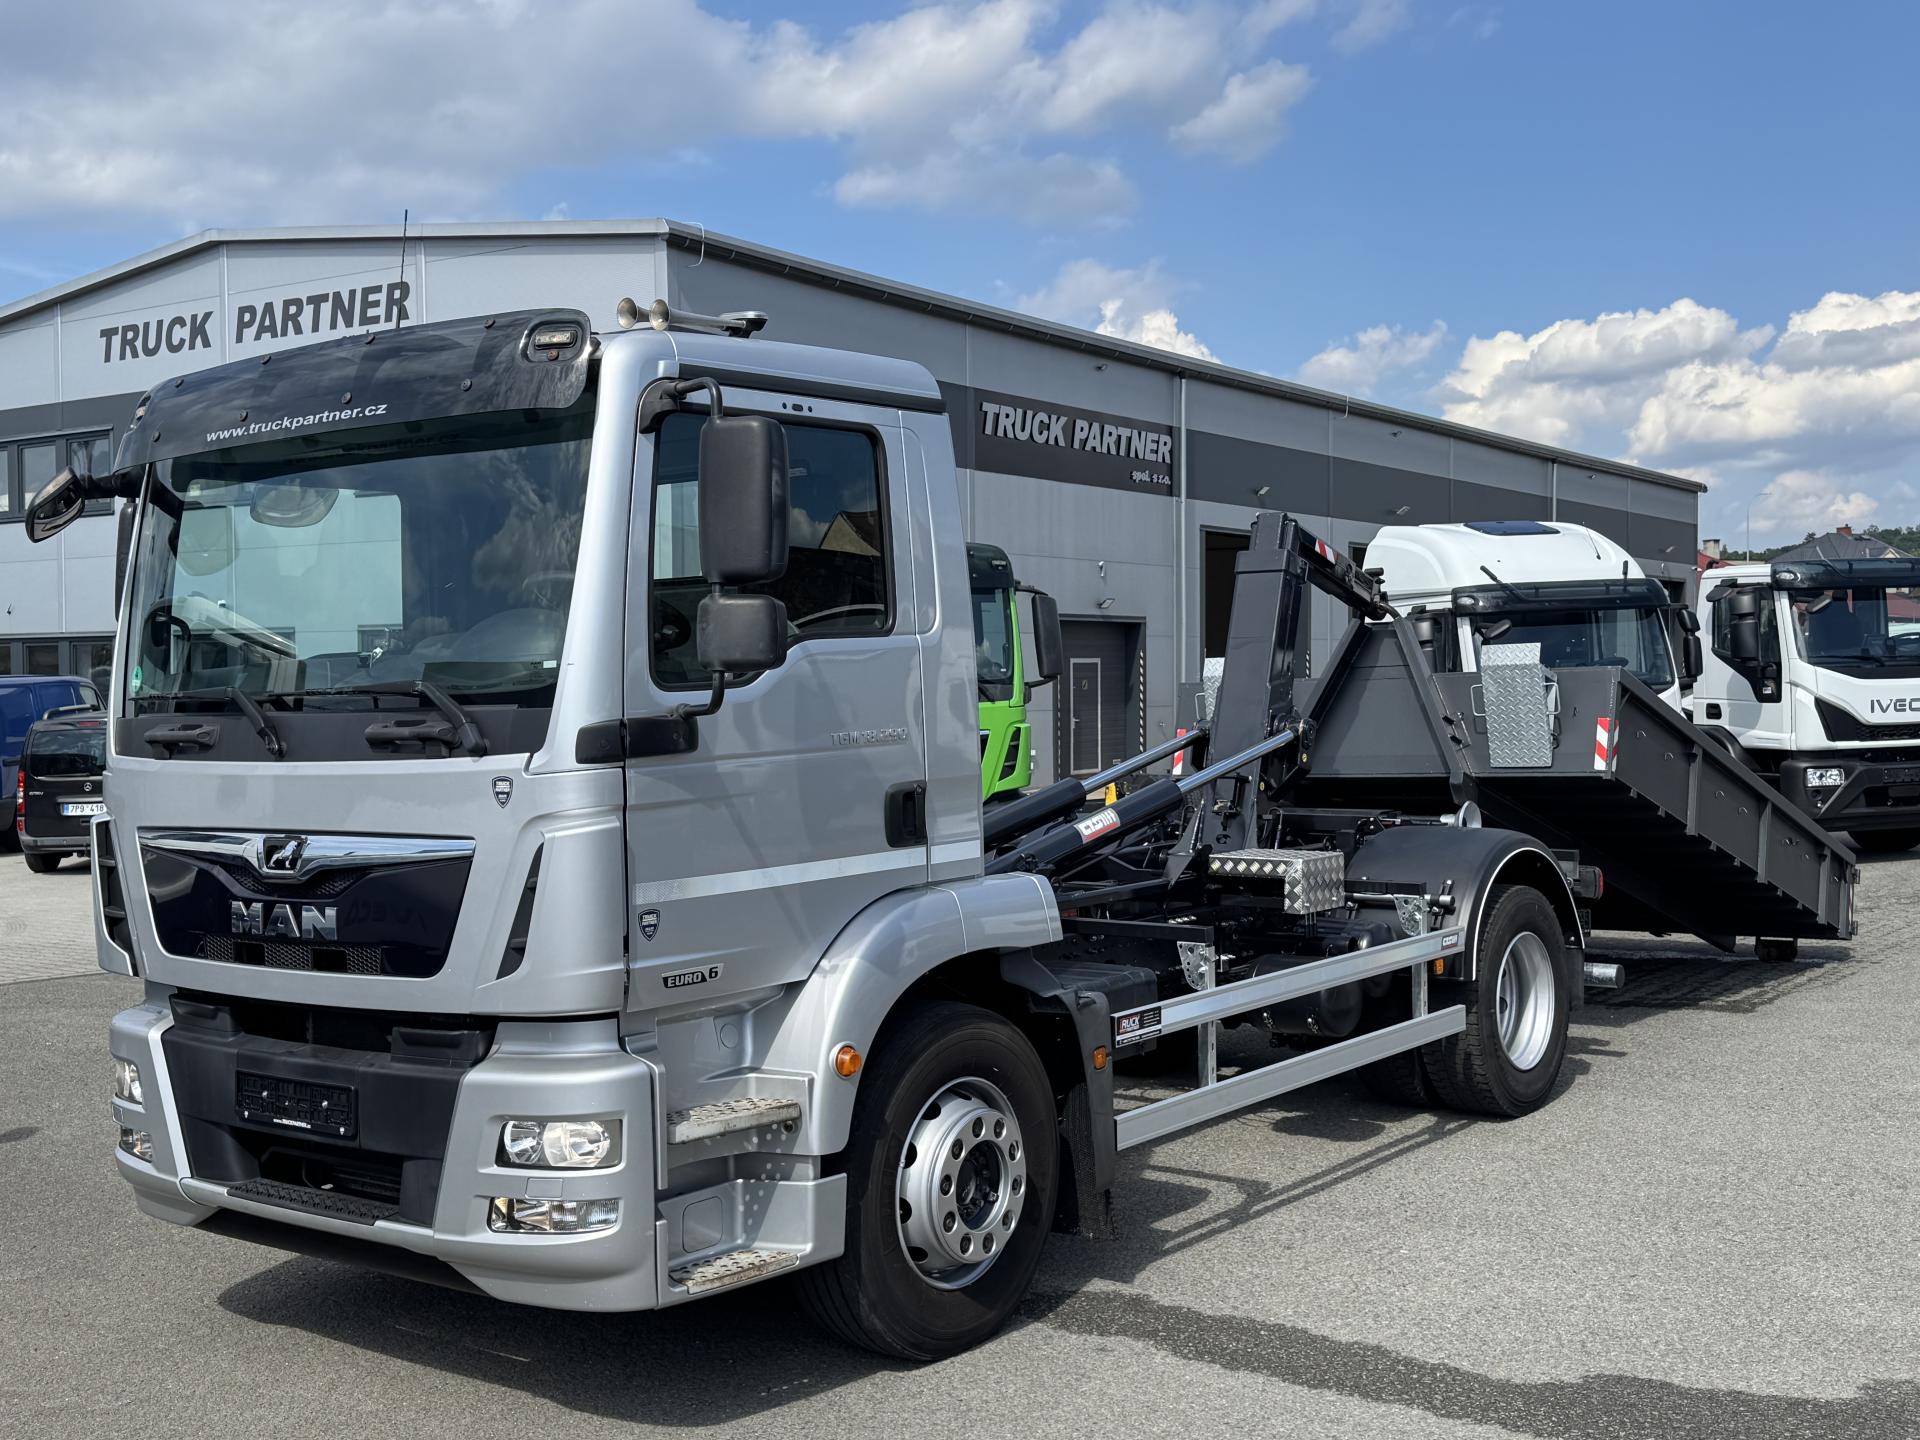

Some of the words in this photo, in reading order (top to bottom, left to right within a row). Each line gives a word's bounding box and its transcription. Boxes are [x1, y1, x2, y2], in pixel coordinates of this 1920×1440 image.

[100, 310, 214, 363] TRUCK
[235, 281, 411, 344] PARTNER
[206, 403, 388, 442] www.truckpartner.cz
[982, 401, 1069, 447] TRUCK
[1073, 419, 1172, 464] PARTNER
[231, 900, 338, 941] MAN
[667, 971, 703, 988] EURO
[708, 966, 719, 980] 6
